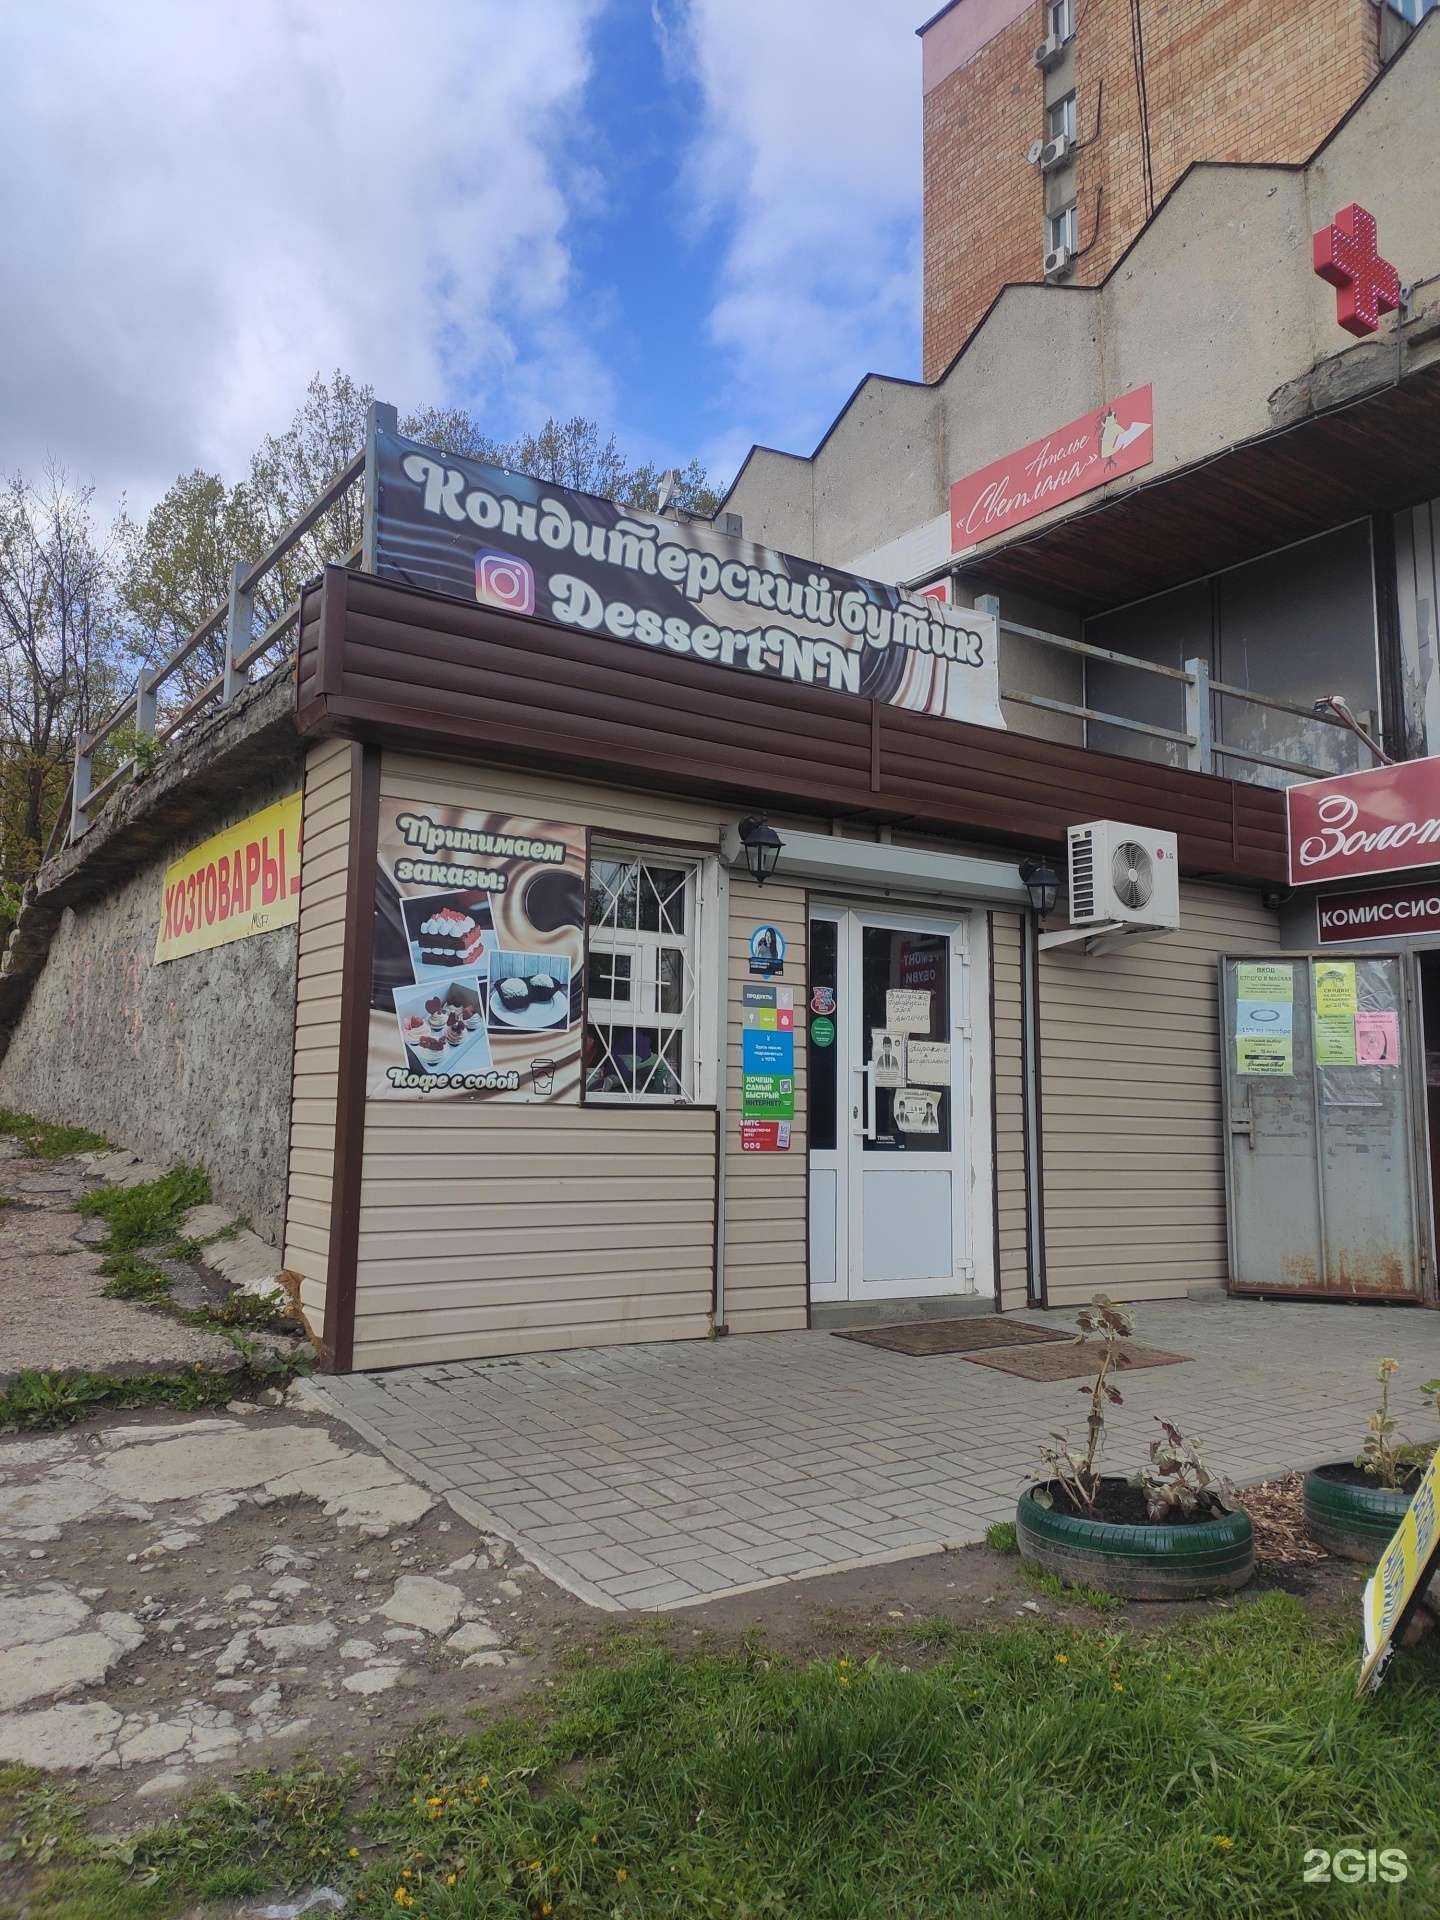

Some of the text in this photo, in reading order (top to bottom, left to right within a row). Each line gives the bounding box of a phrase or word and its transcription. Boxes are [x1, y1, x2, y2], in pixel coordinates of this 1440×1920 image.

[1024, 435, 1090, 478] Ателье
[956, 453, 1098, 534] «Светлана»
[403, 452, 983, 666] Кондитерский бутик
[398, 817, 564, 861] Принимаем
[398, 862, 506, 890] заказы:
[1321, 898, 1440, 928] КОМИССИО
[388, 1069, 519, 1092] Кофе с собой
